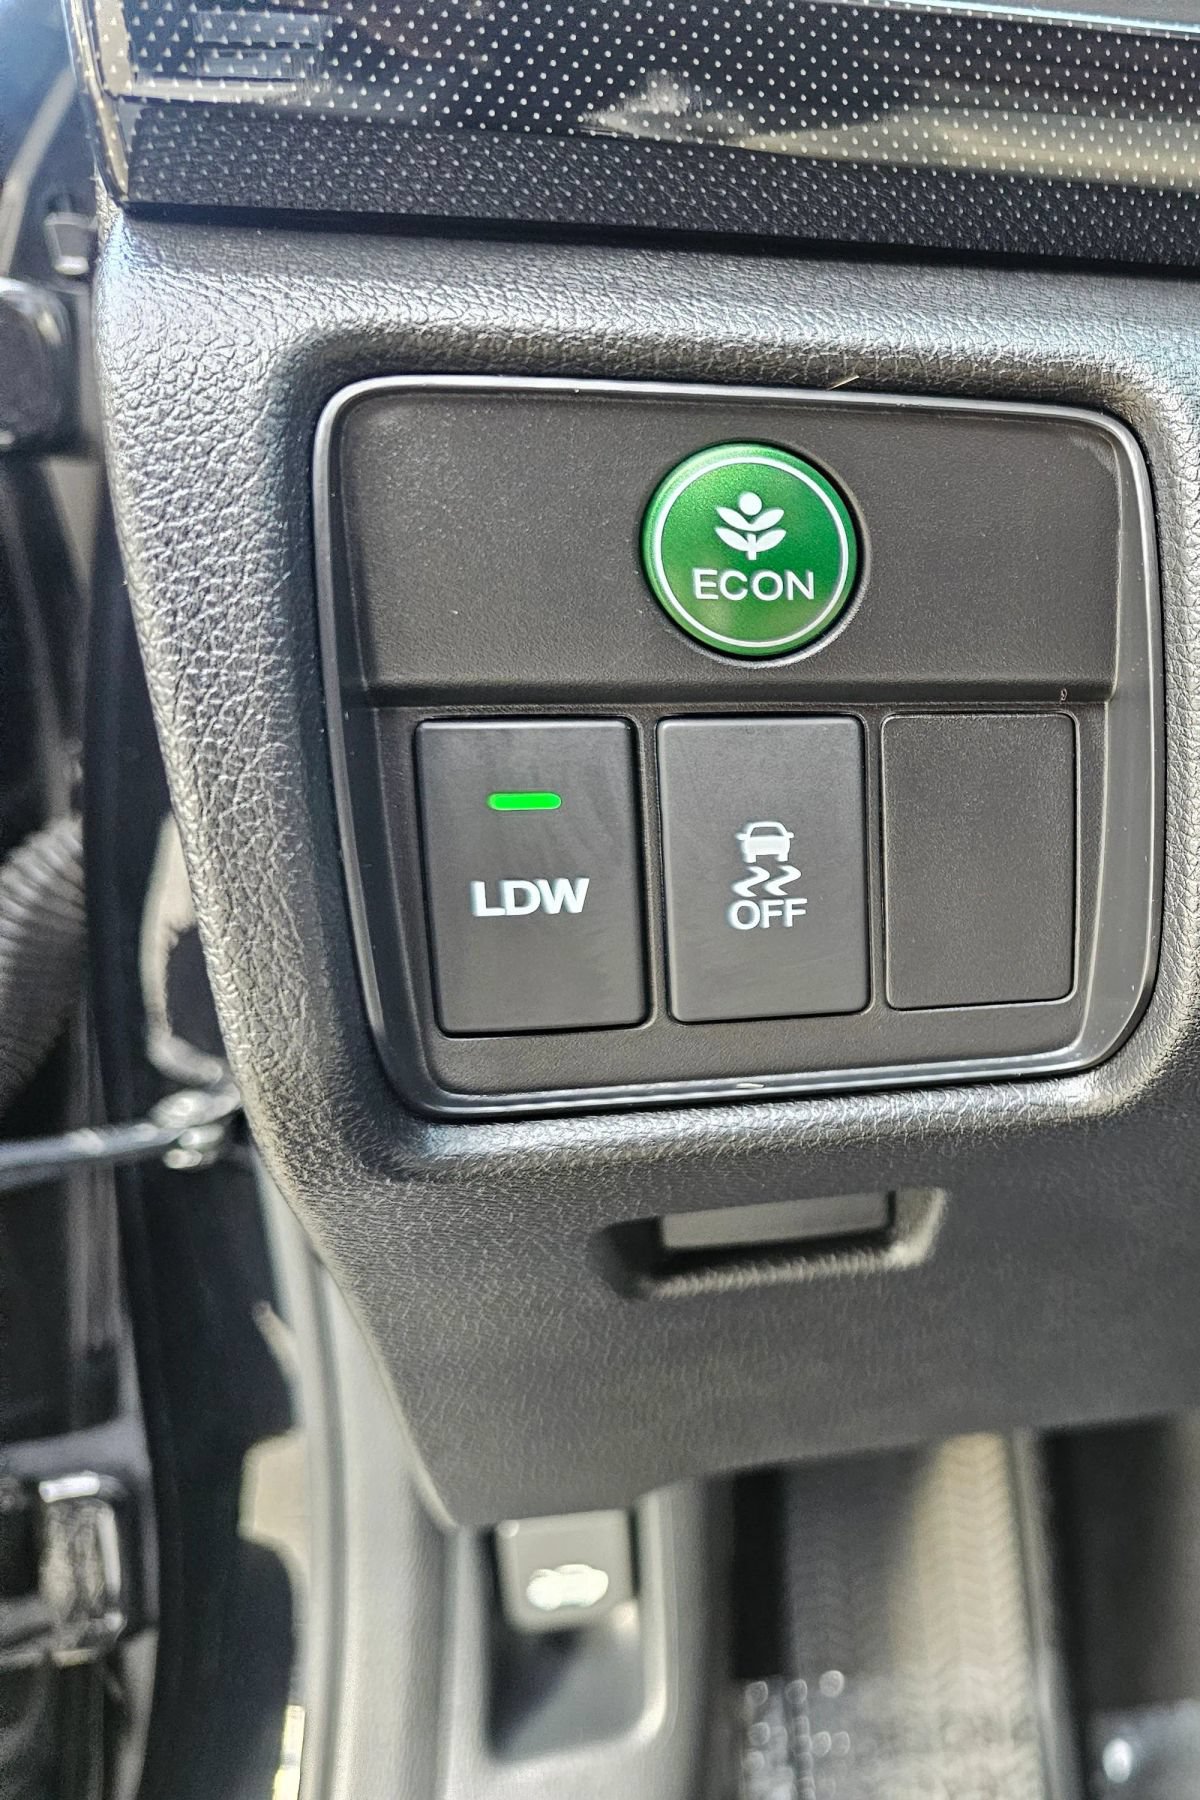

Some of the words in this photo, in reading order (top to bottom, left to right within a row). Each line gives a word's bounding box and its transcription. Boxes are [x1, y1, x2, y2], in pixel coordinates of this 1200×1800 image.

[693, 568, 814, 601] ECON
[470, 878, 590, 917] LDW
[727, 898, 808, 930] OFF
